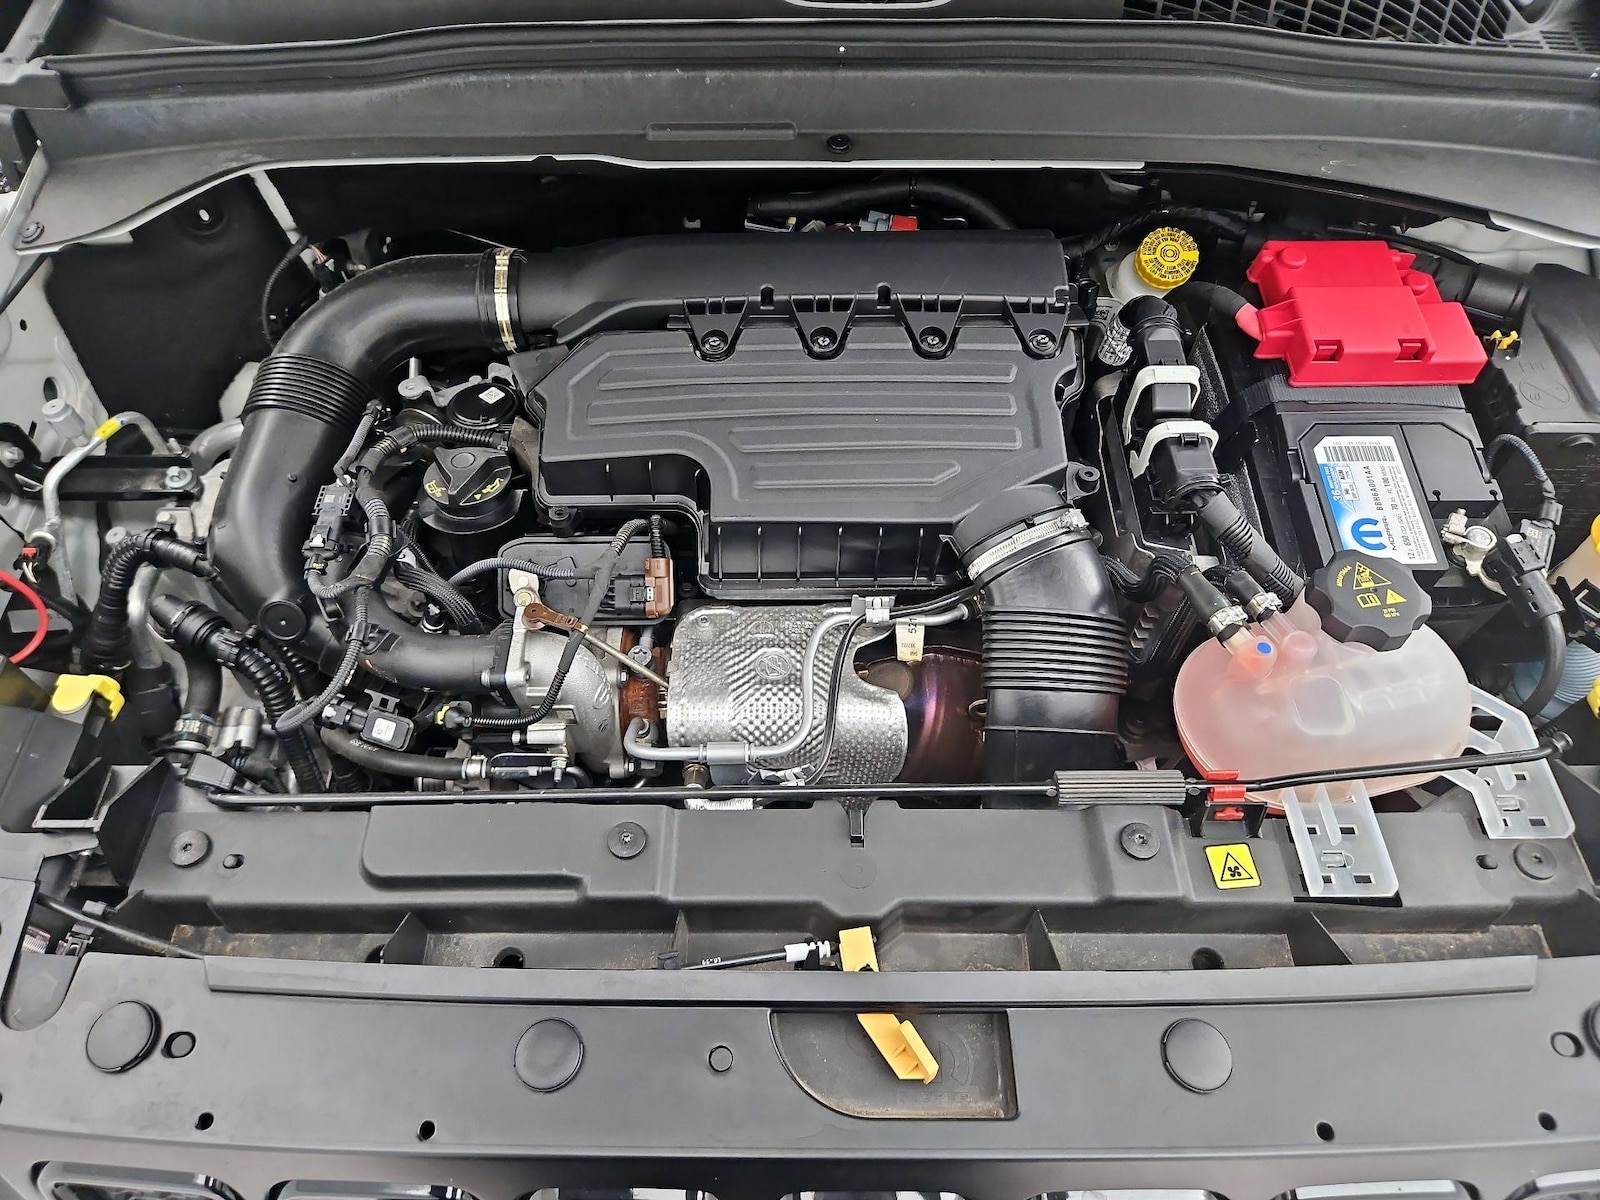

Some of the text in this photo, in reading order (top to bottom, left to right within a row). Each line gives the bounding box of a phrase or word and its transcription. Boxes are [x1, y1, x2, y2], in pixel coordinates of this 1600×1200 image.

[1382, 477, 1390, 486] 100
[1333, 489, 1342, 501] 36
[1383, 517, 1397, 551] MOPAR
[1402, 535, 1411, 546] 650
[908, 618, 917, 634] 521
